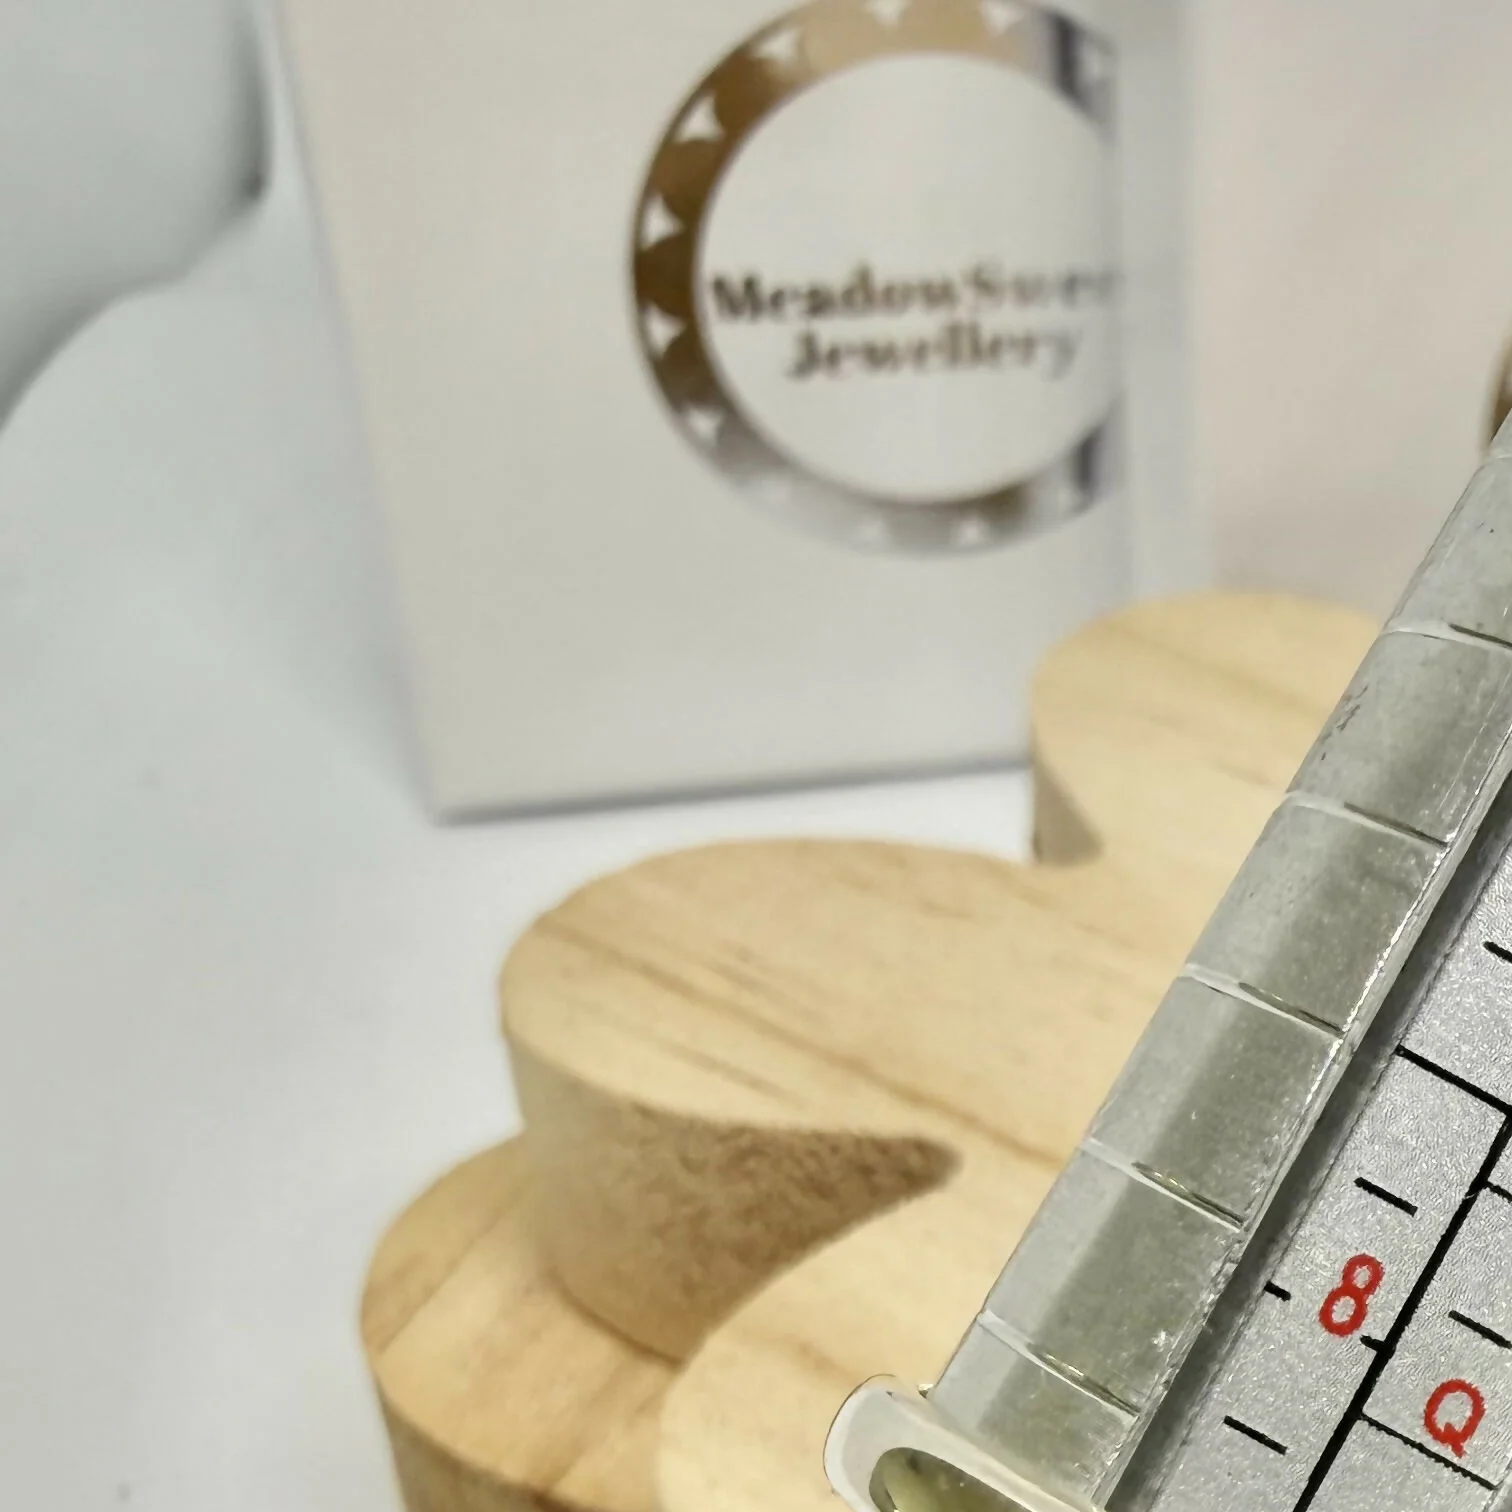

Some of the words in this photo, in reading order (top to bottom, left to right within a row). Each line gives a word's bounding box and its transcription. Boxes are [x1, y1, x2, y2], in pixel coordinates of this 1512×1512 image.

[786, 323, 1082, 379] Jewellery
[1318, 1253, 1385, 1338] 8
[1423, 1378, 1486, 1457] Q
